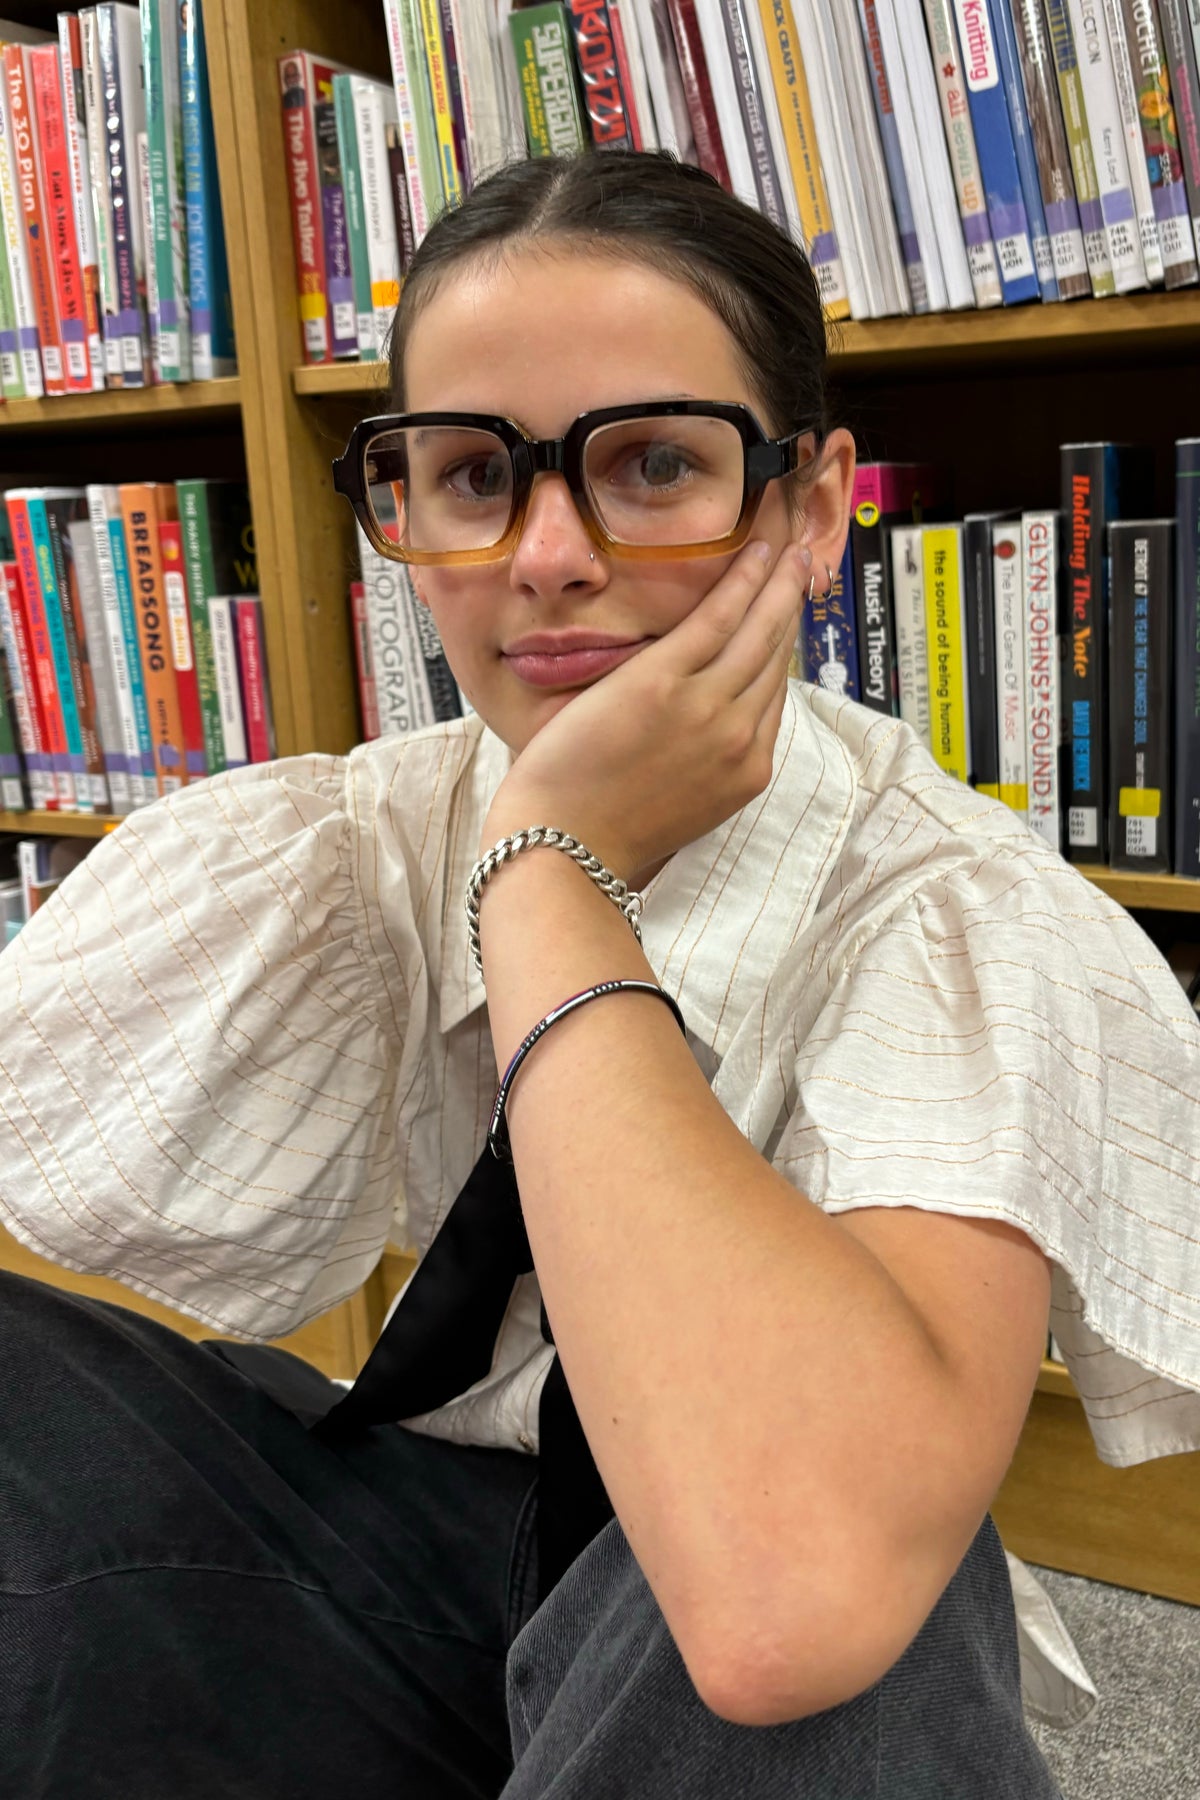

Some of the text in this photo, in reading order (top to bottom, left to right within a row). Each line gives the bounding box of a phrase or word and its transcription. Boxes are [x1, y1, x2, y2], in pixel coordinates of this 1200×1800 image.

[778, 29, 796, 86] CRAFTS
[962, 0, 989, 82] Knitting
[737, 58, 771, 172] AND CITIES IN 15
[791, 91, 800, 109] FOR
[9, 63, 35, 212] The 30 Plan
[288, 110, 305, 154] The
[795, 111, 807, 150] PARENTS
[946, 89, 981, 209] all sewn up
[186, 152, 202, 192] PLAN
[291, 158, 309, 198] Jive
[802, 152, 812, 173] WHO
[1102, 127, 1120, 186] Kerry Lord
[152, 151, 167, 241] FEED ME VEGAN
[331, 191, 343, 214] The
[807, 174, 817, 201] THINK
[187, 203, 207, 303] JOE WICKS
[297, 199, 315, 267] Talker
[1113, 245, 1134, 258] LOR
[1069, 475, 1092, 679] Holding The Note
[1134, 538, 1149, 581] DETROIT
[131, 511, 166, 673] BREADSONG
[911, 588, 922, 609] This
[1134, 598, 1149, 617] THE
[863, 561, 888, 700] Music Theory
[913, 628, 926, 674] YOUR
[935, 551, 952, 756] the sound of being human
[1002, 564, 1019, 741] The Inner Game Of Music
[1134, 619, 1148, 645] YEAR
[900, 643, 914, 700] MUSIC
[1029, 521, 1052, 797] GLYN JOHNS SOUND
[1134, 646, 1148, 670] THAT
[916, 683, 930, 738] BRAIN
[1134, 672, 1148, 717] CHANGED
[1134, 719, 1148, 745] SOUL
